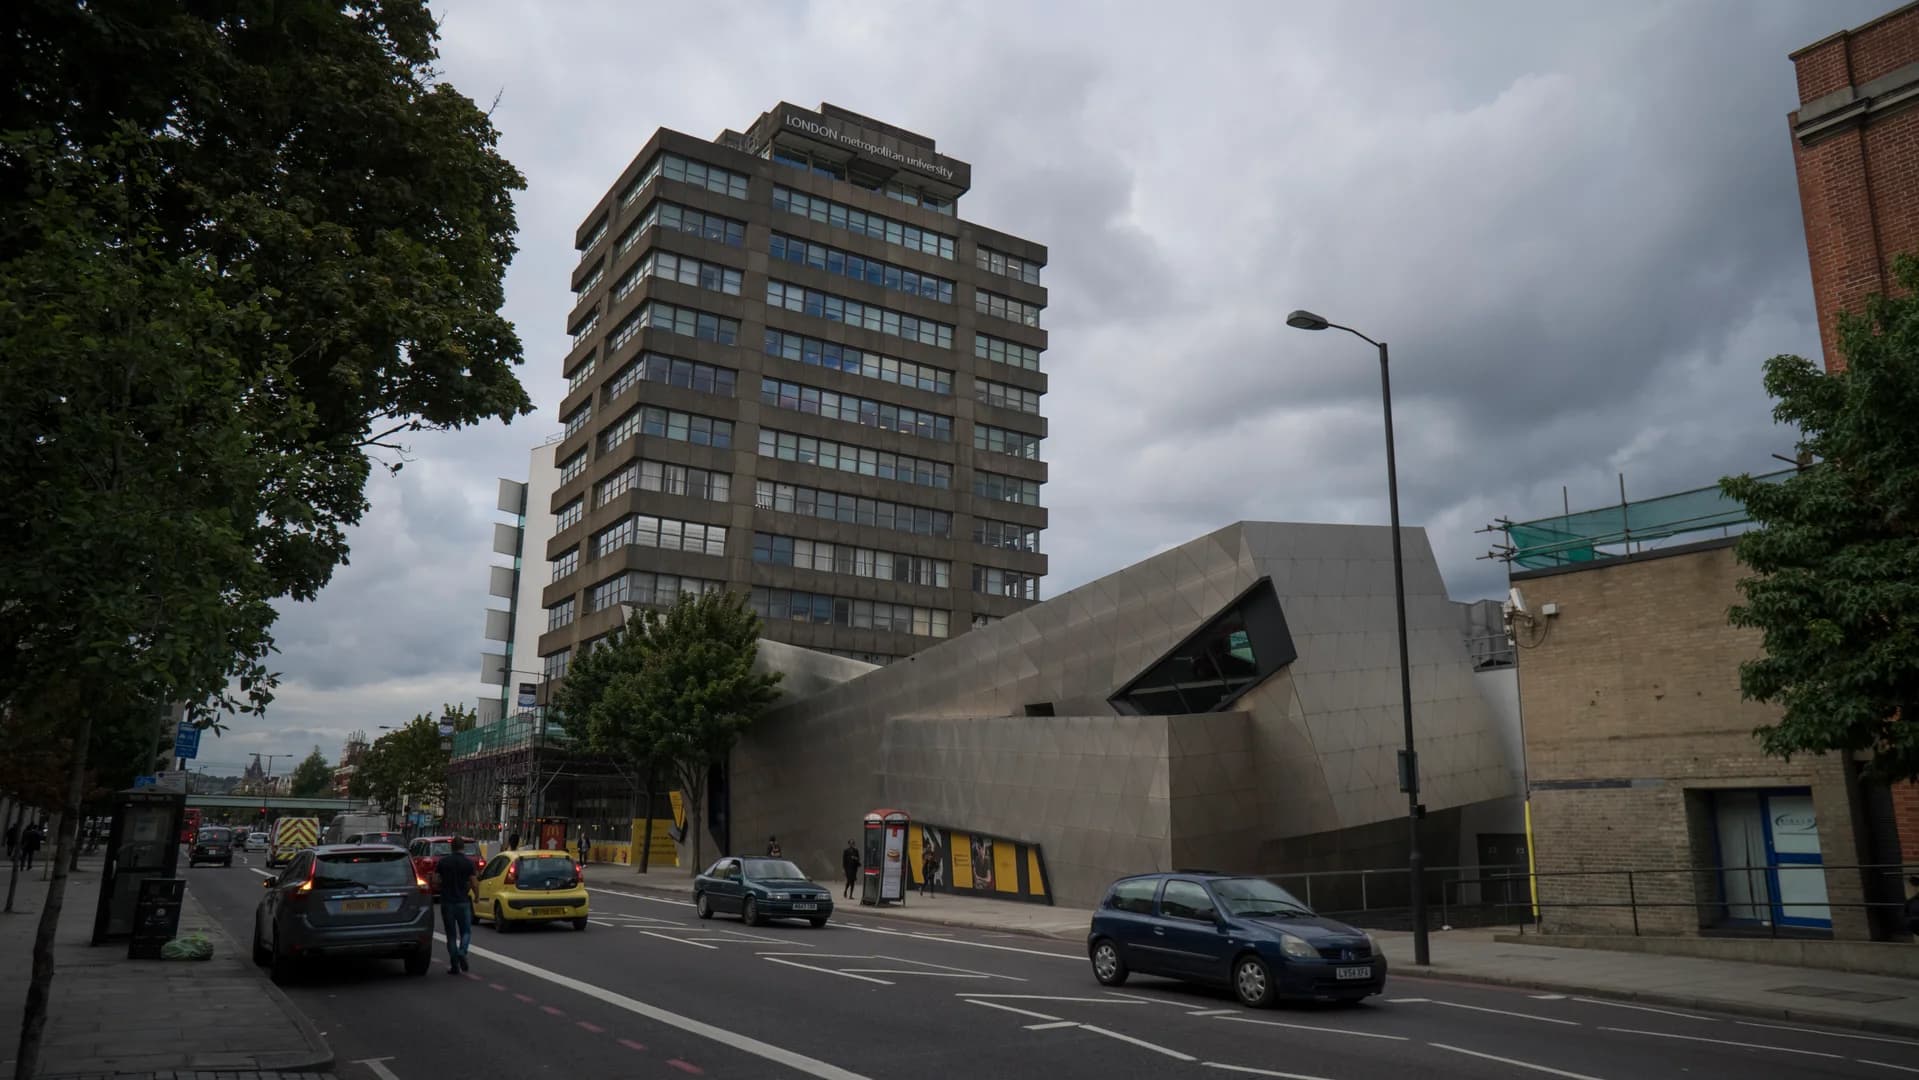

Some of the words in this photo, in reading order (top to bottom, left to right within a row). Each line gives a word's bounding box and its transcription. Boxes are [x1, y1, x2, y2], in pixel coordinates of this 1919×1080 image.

[786, 114, 838, 140] LONDON
[840, 134, 904, 162] metropolitan
[907, 157, 954, 180] university
